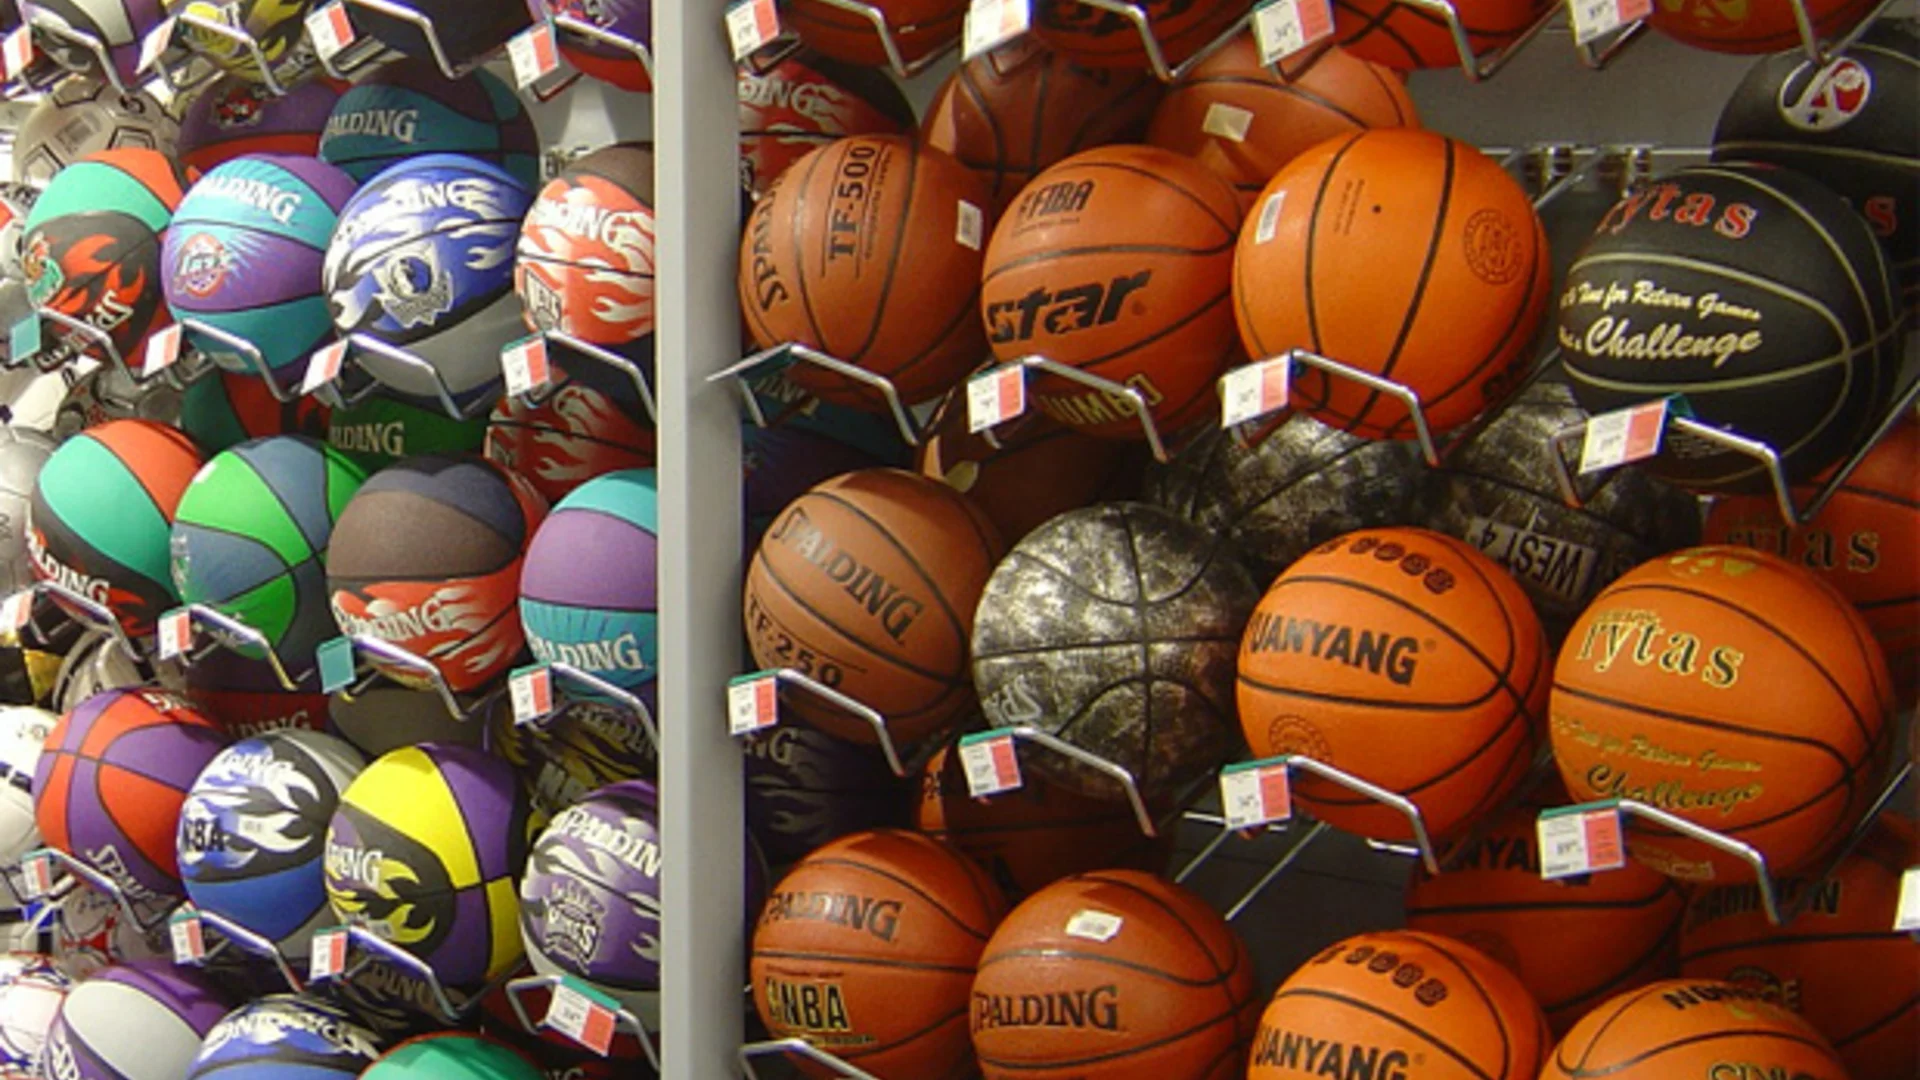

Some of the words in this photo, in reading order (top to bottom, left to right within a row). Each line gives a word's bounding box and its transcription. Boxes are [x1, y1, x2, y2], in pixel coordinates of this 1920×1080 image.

[829, 146, 876, 263] TF-500
[1585, 315, 1763, 368] Challenge
[771, 507, 924, 645] SPALDING
[1499, 532, 1583, 598] WEST
[1577, 616, 1744, 688] rytas
